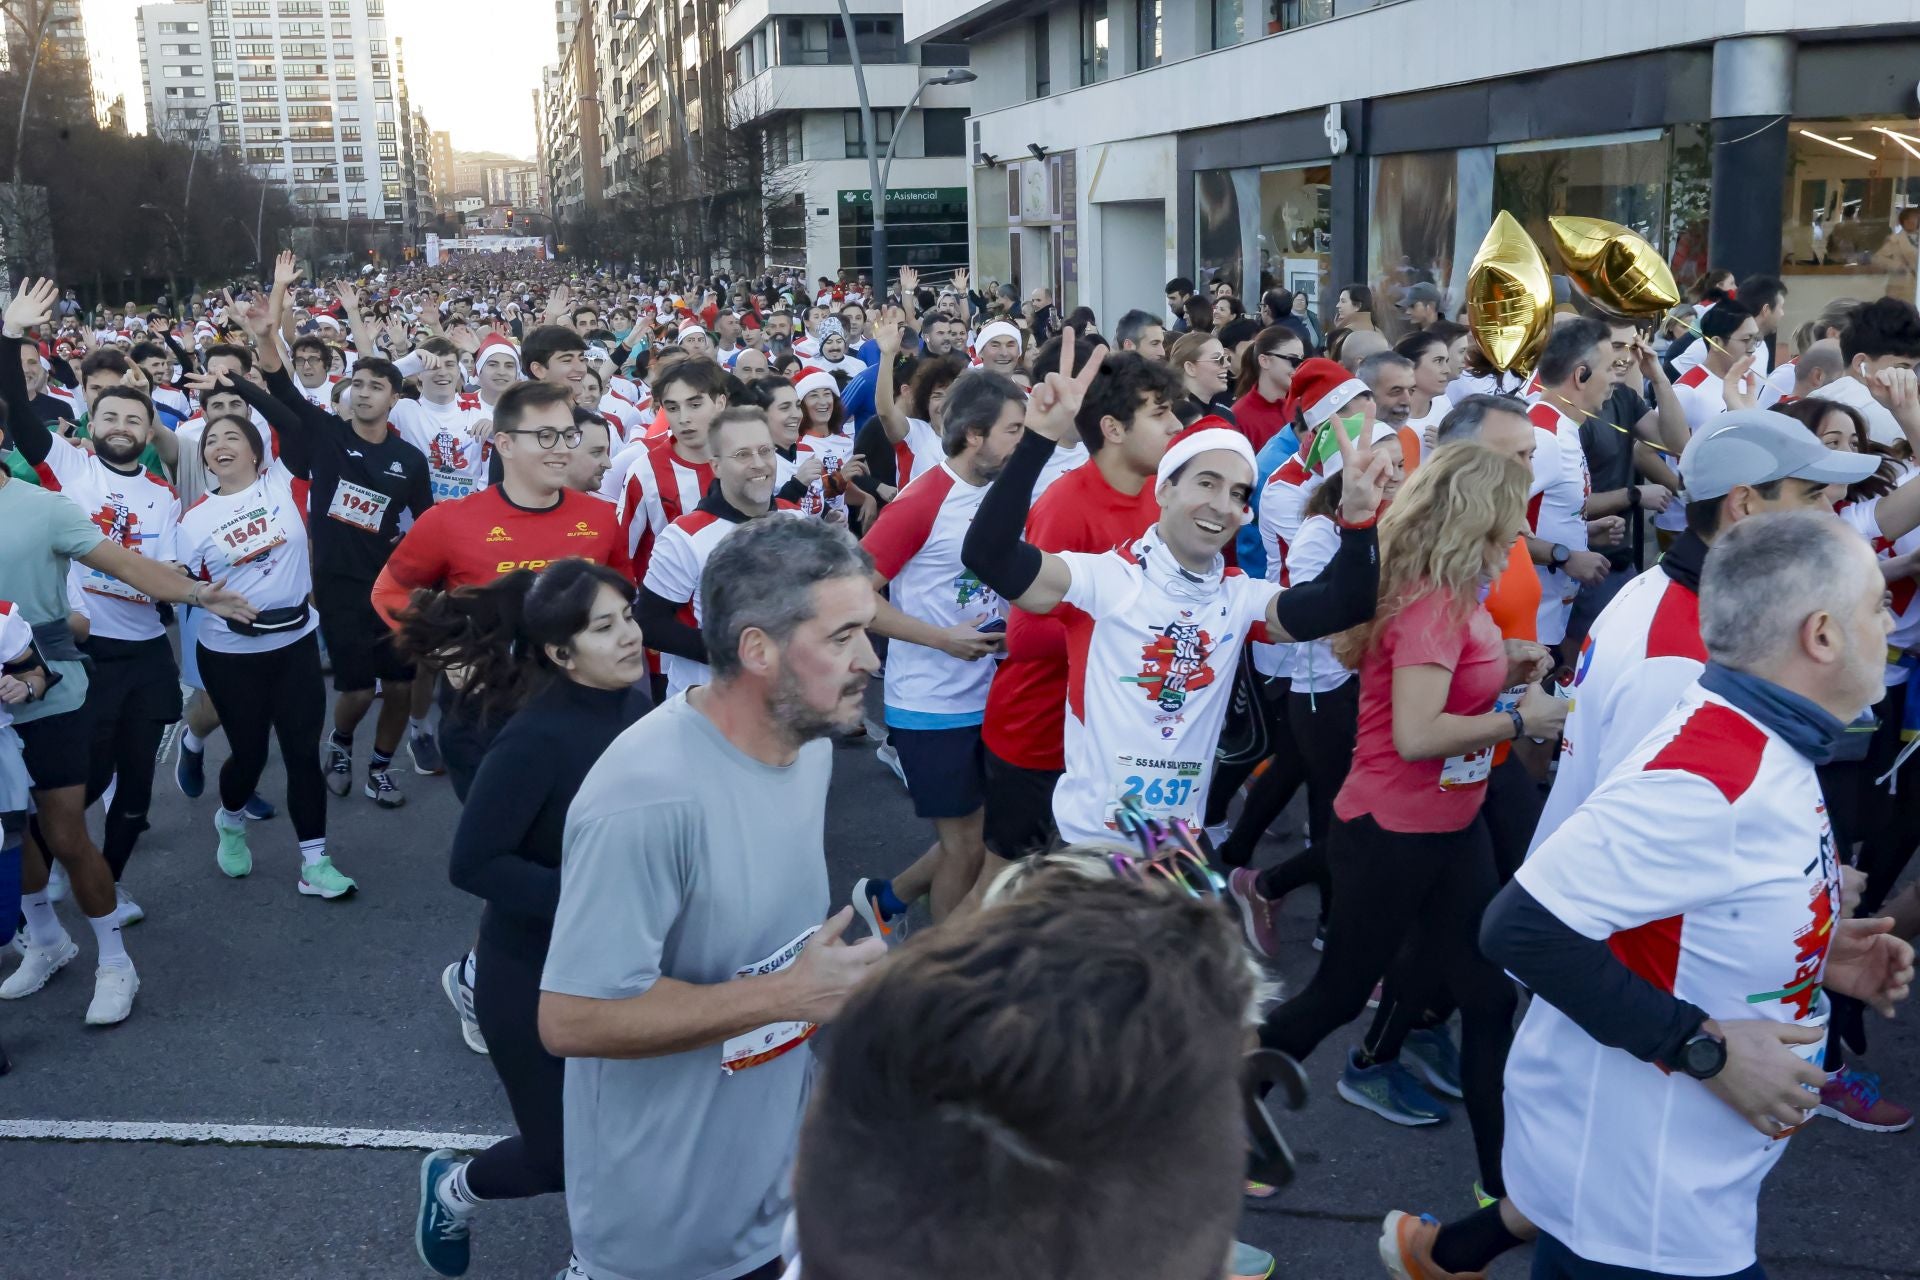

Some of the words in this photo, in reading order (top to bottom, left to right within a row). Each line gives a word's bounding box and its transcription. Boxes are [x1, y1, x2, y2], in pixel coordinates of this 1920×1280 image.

[893, 190, 938, 200] Asistencial
[342, 493, 379, 516] 1947
[223, 517, 268, 549] 1547
[1175, 641, 1201, 659] SIL
[1135, 758, 1148, 767] 55
[1148, 759, 1167, 769] SAN
[1166, 761, 1202, 770] SILVESTRE
[1121, 775, 1193, 806] 2637
